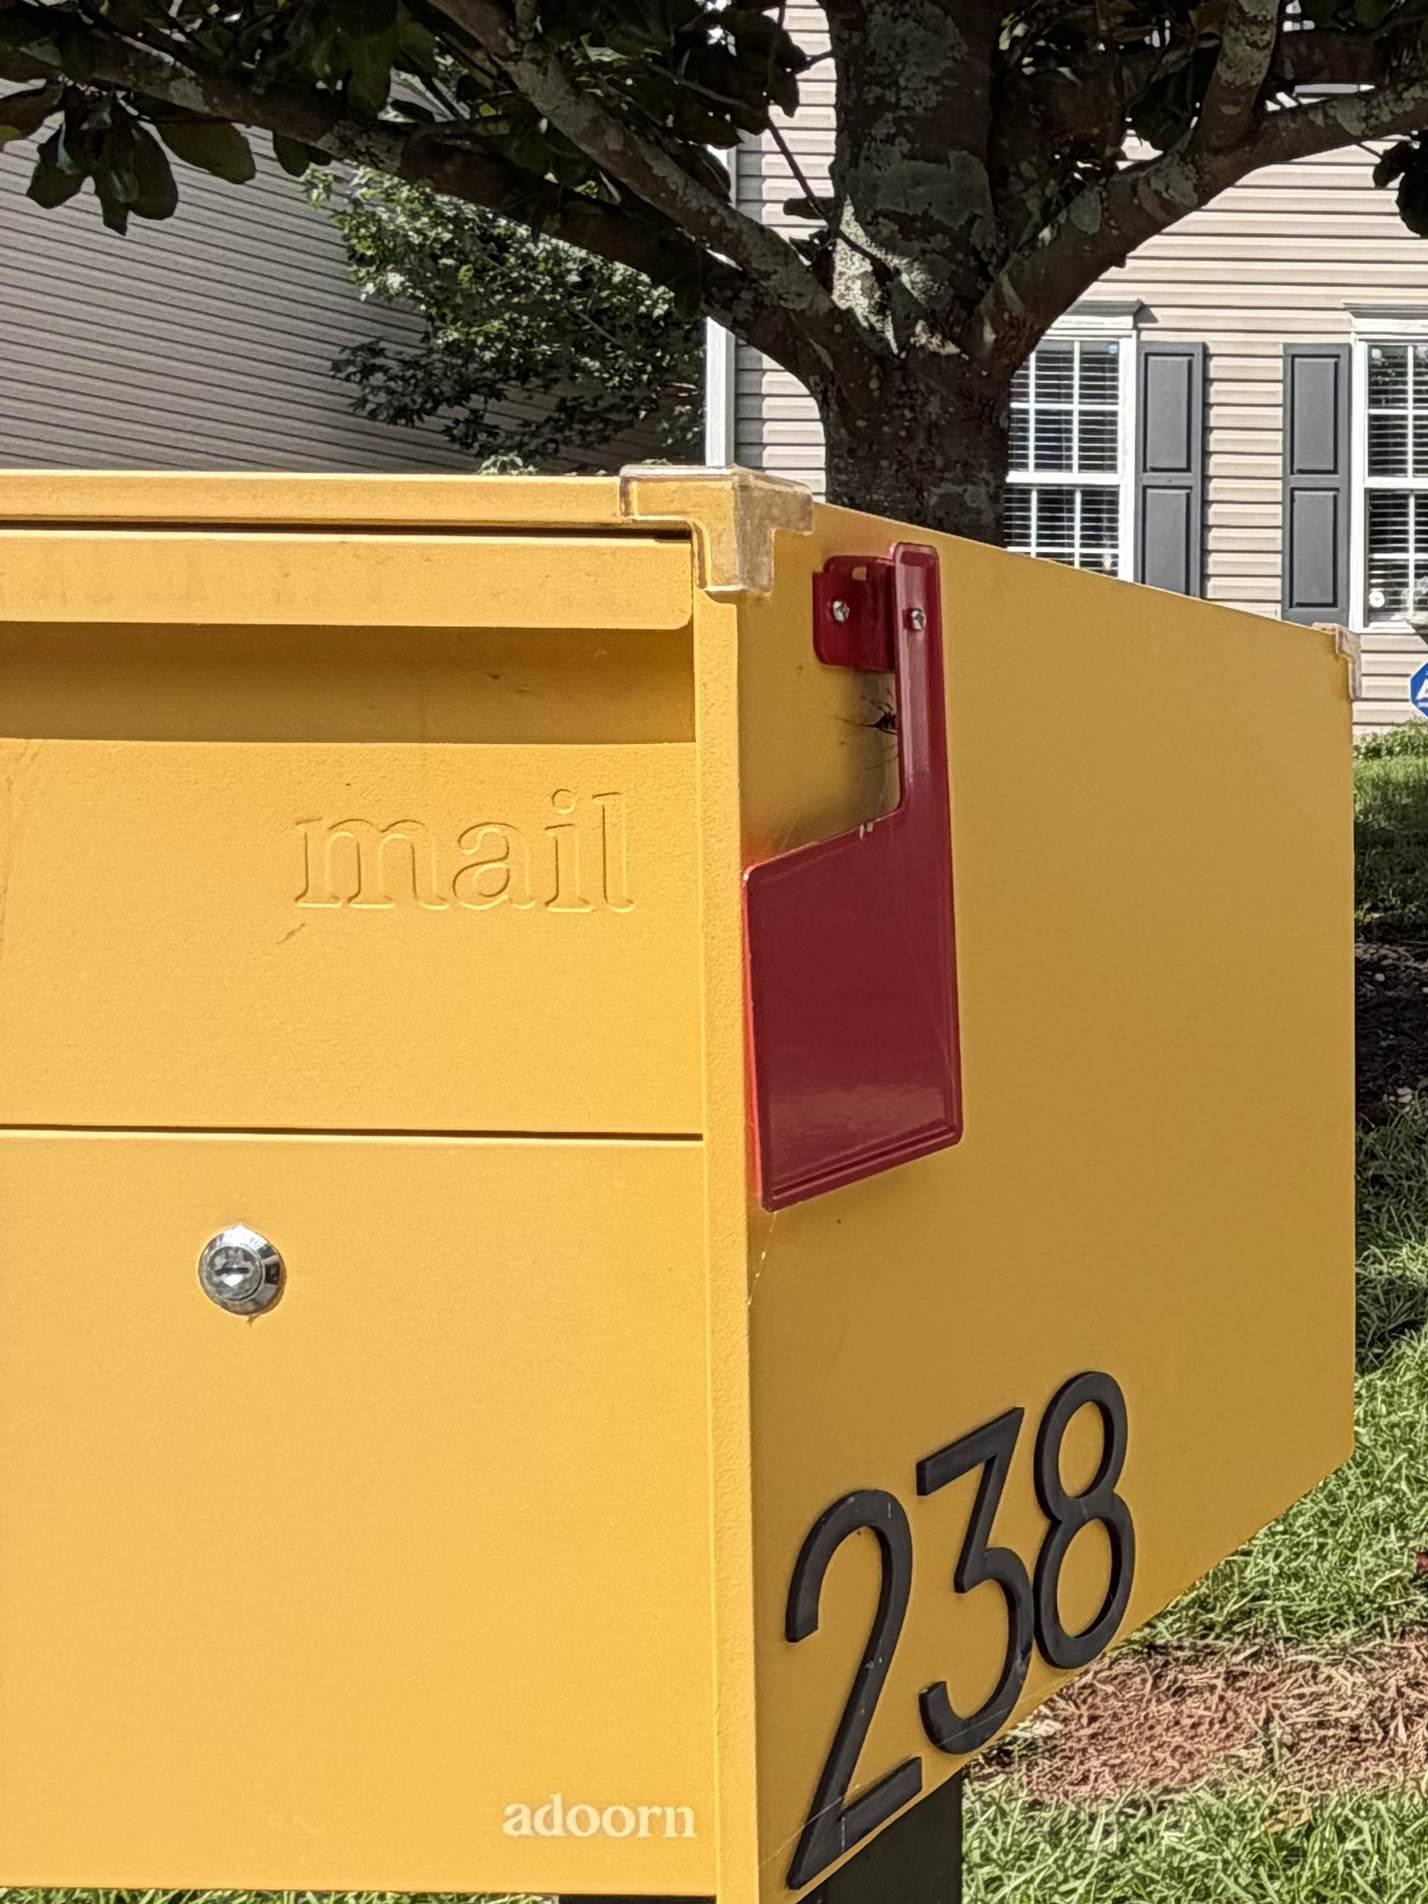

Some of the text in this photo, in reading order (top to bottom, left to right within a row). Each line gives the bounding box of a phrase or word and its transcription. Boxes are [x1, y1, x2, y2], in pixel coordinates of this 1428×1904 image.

[294, 788, 635, 912] mail
[785, 1371, 1135, 1890] 238
[502, 1793, 697, 1838] adoorn
